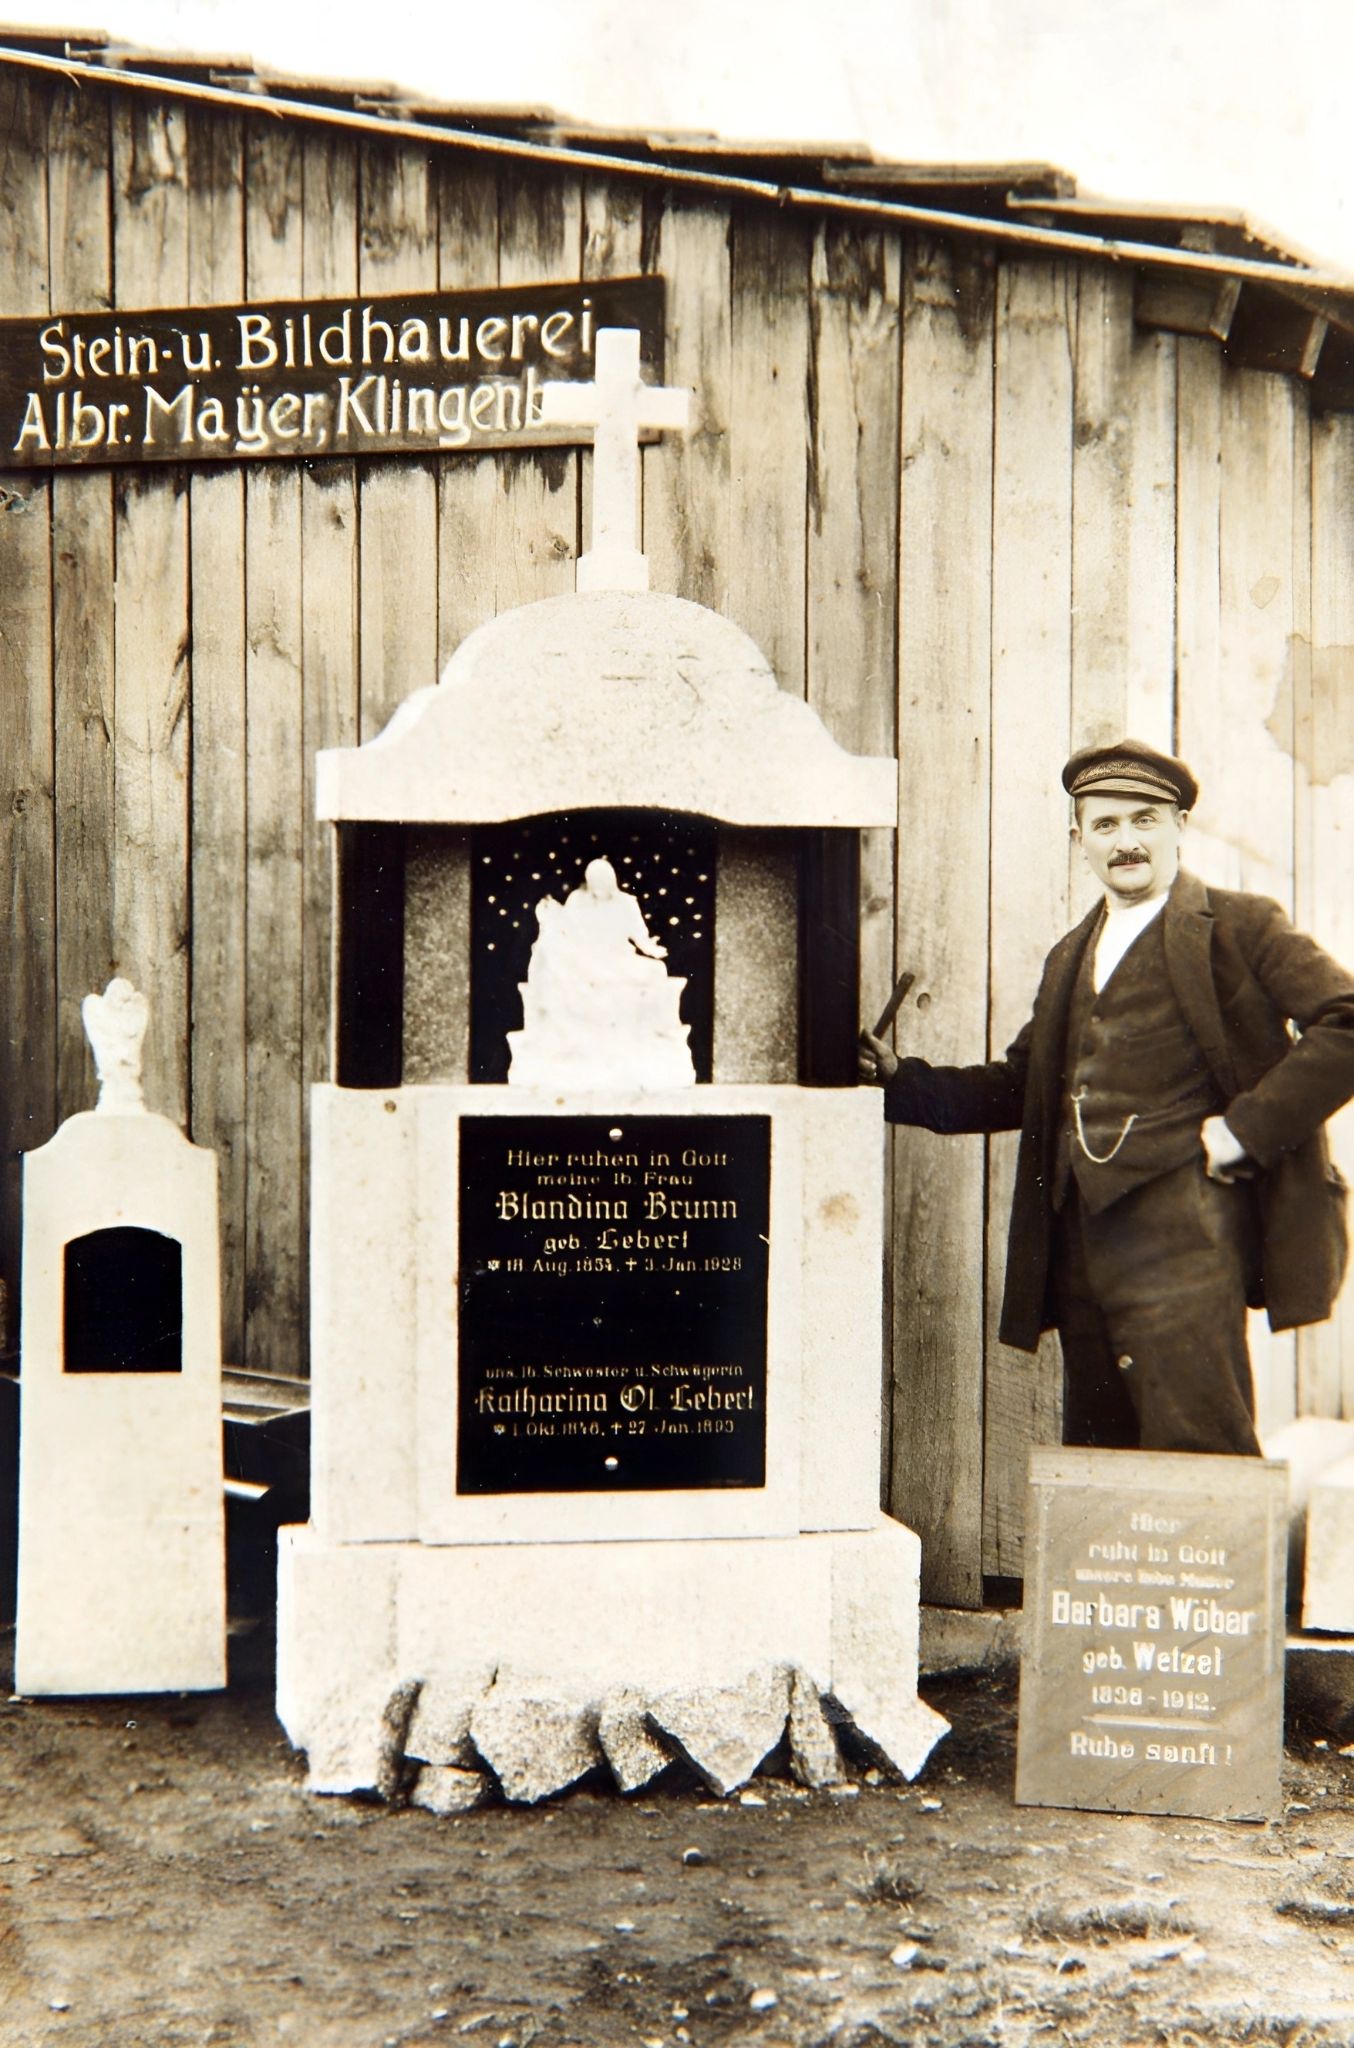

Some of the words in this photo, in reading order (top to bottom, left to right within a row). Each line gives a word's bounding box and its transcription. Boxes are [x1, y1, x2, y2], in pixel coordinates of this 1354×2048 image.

[235, 297, 593, 371] Bildhauerei
[13, 388, 133, 452] Albr.
[507, 1149, 560, 1167] Hier
[566, 1149, 639, 1167] ruhen
[650, 1150, 671, 1167] in
[537, 1171, 600, 1187] meine
[644, 1171, 694, 1187] Frau
[495, 1190, 629, 1222] Blandina
[643, 1190, 739, 1221] Brunn
[542, 1362, 630, 1380] Schwester
[474, 1386, 608, 1418] Katharina
[1052, 1591, 1161, 1629] Barbara
[1070, 1731, 1135, 1760] Ruhe
